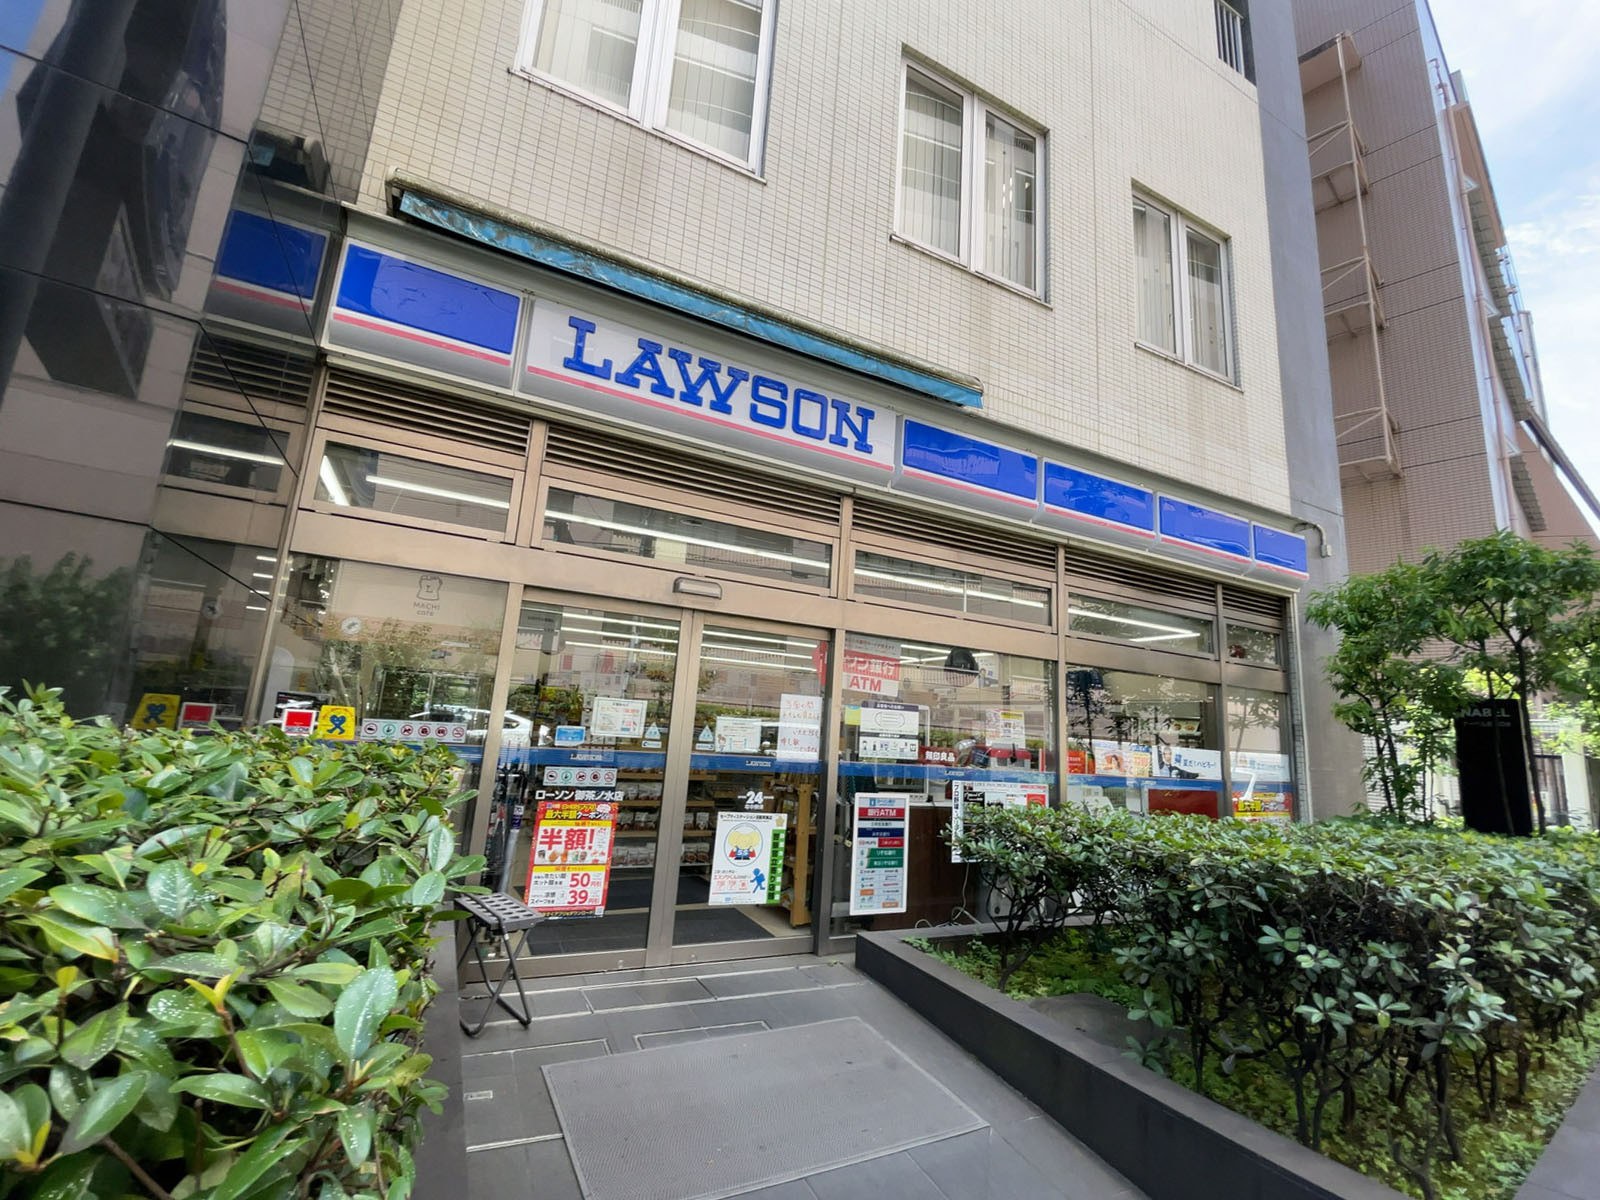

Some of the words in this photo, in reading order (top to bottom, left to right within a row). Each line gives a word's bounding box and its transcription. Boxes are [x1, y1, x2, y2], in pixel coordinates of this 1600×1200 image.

[563, 316, 875, 454] LAWSON
[849, 675, 882, 692] ATM
[925, 751, 955, 762] 無印良品
[746, 790, 764, 804] 24
[569, 872, 591, 888] 50
[567, 889, 589, 905] 39
